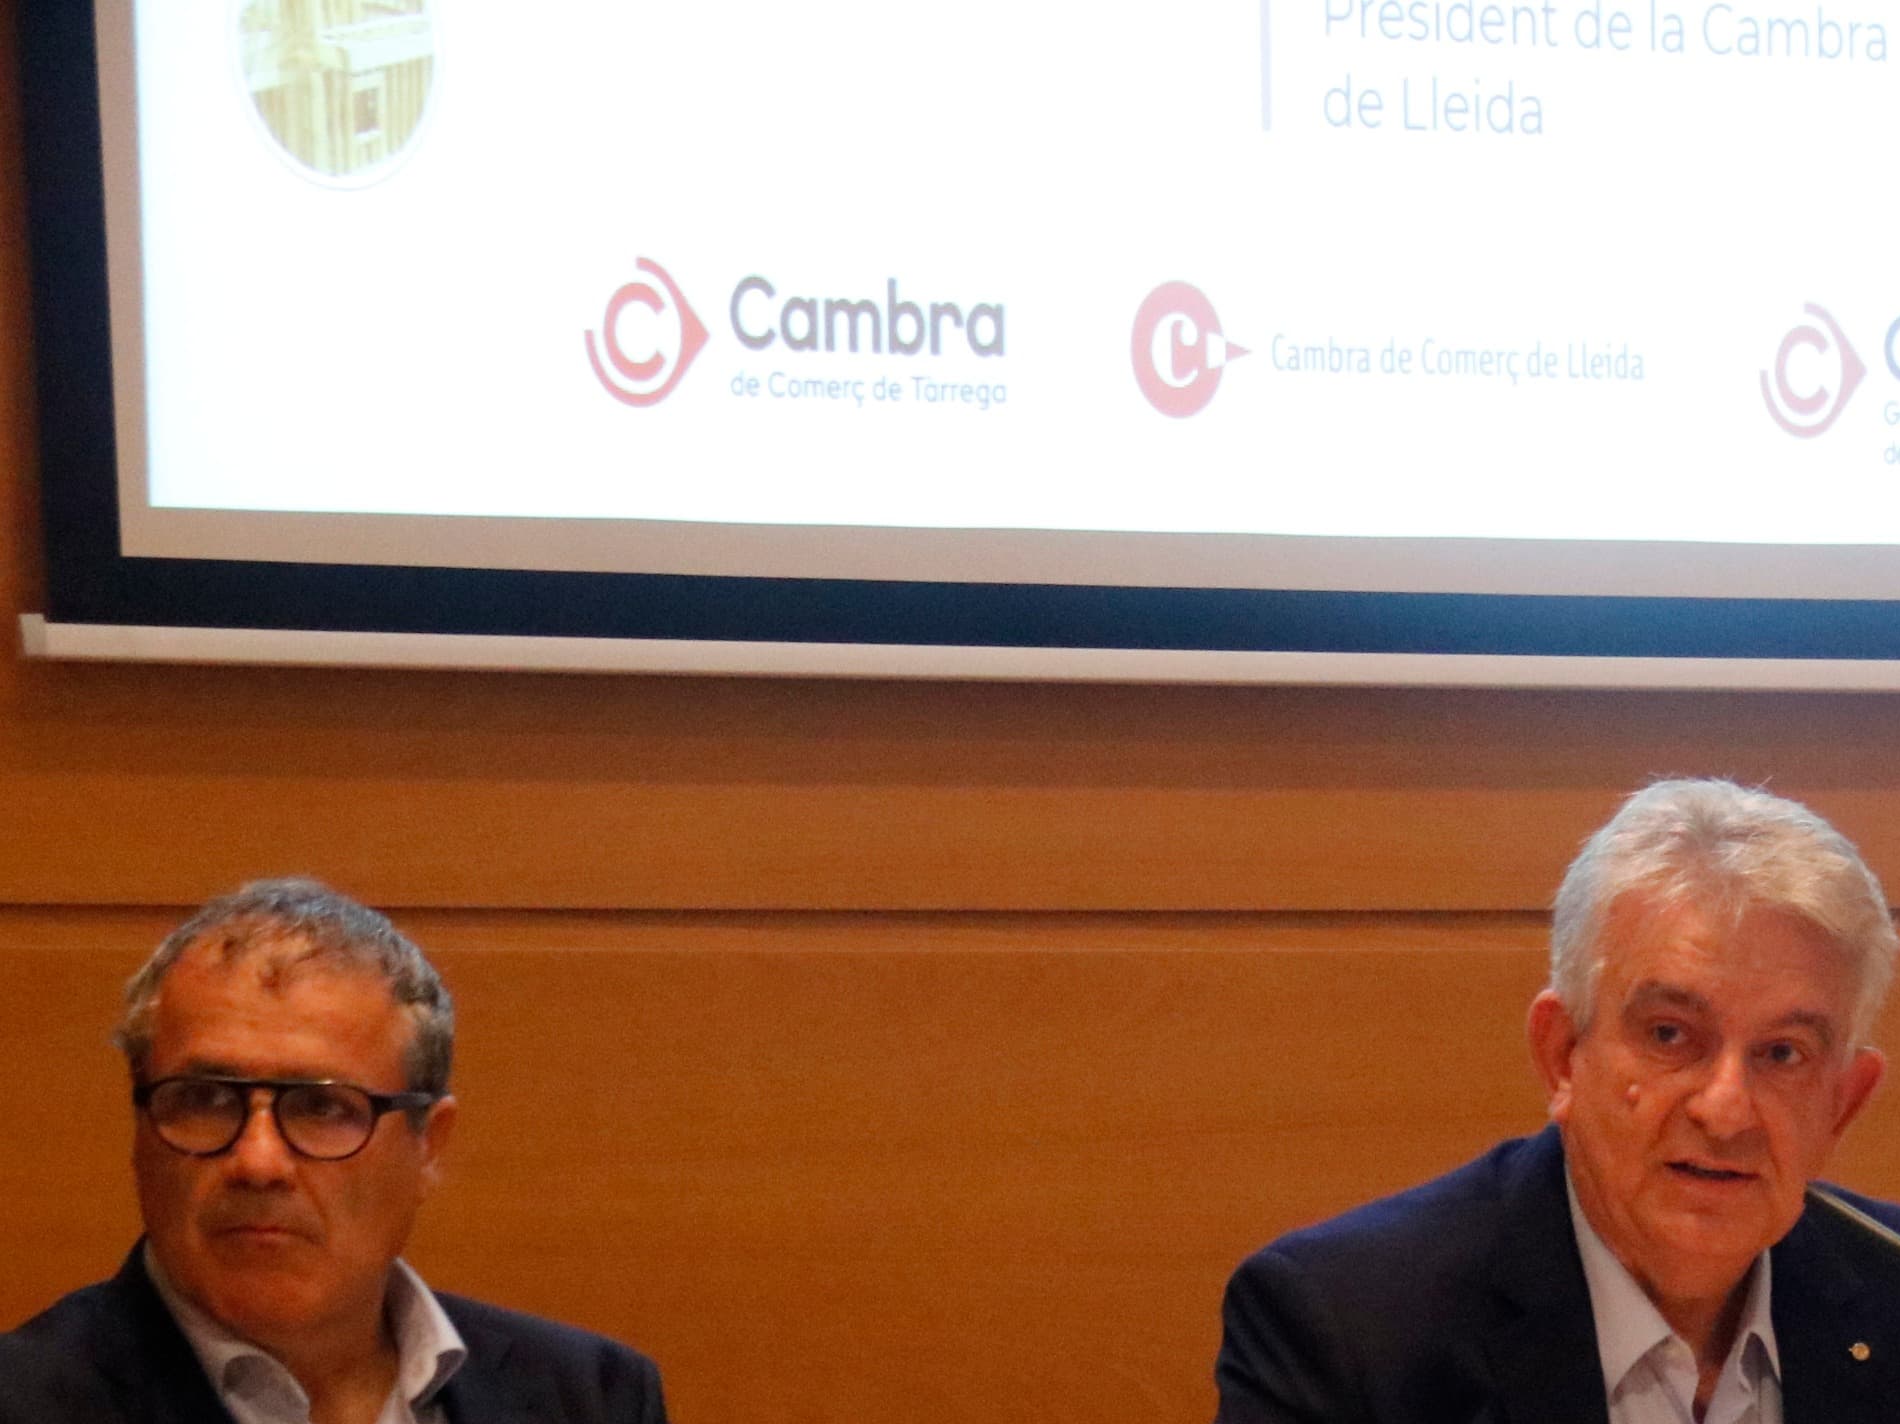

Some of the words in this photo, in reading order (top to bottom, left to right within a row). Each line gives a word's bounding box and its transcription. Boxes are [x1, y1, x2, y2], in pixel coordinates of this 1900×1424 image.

[1324, 0, 1559, 47] President
[1574, 0, 1632, 50] de
[1650, 0, 1685, 53] la
[1702, 2, 1888, 62] Cambra
[1323, 72, 1384, 128] de
[1402, 72, 1543, 135] Lleida
[729, 272, 1006, 358] Cambra
[729, 369, 761, 398] de
[767, 371, 866, 409] Comerç
[872, 376, 902, 402] de
[1271, 333, 1374, 374] Cambra
[1380, 336, 1414, 376] de
[1420, 337, 1523, 387] Comerç
[1525, 341, 1560, 379] de
[1566, 343, 1646, 382] Lleida
